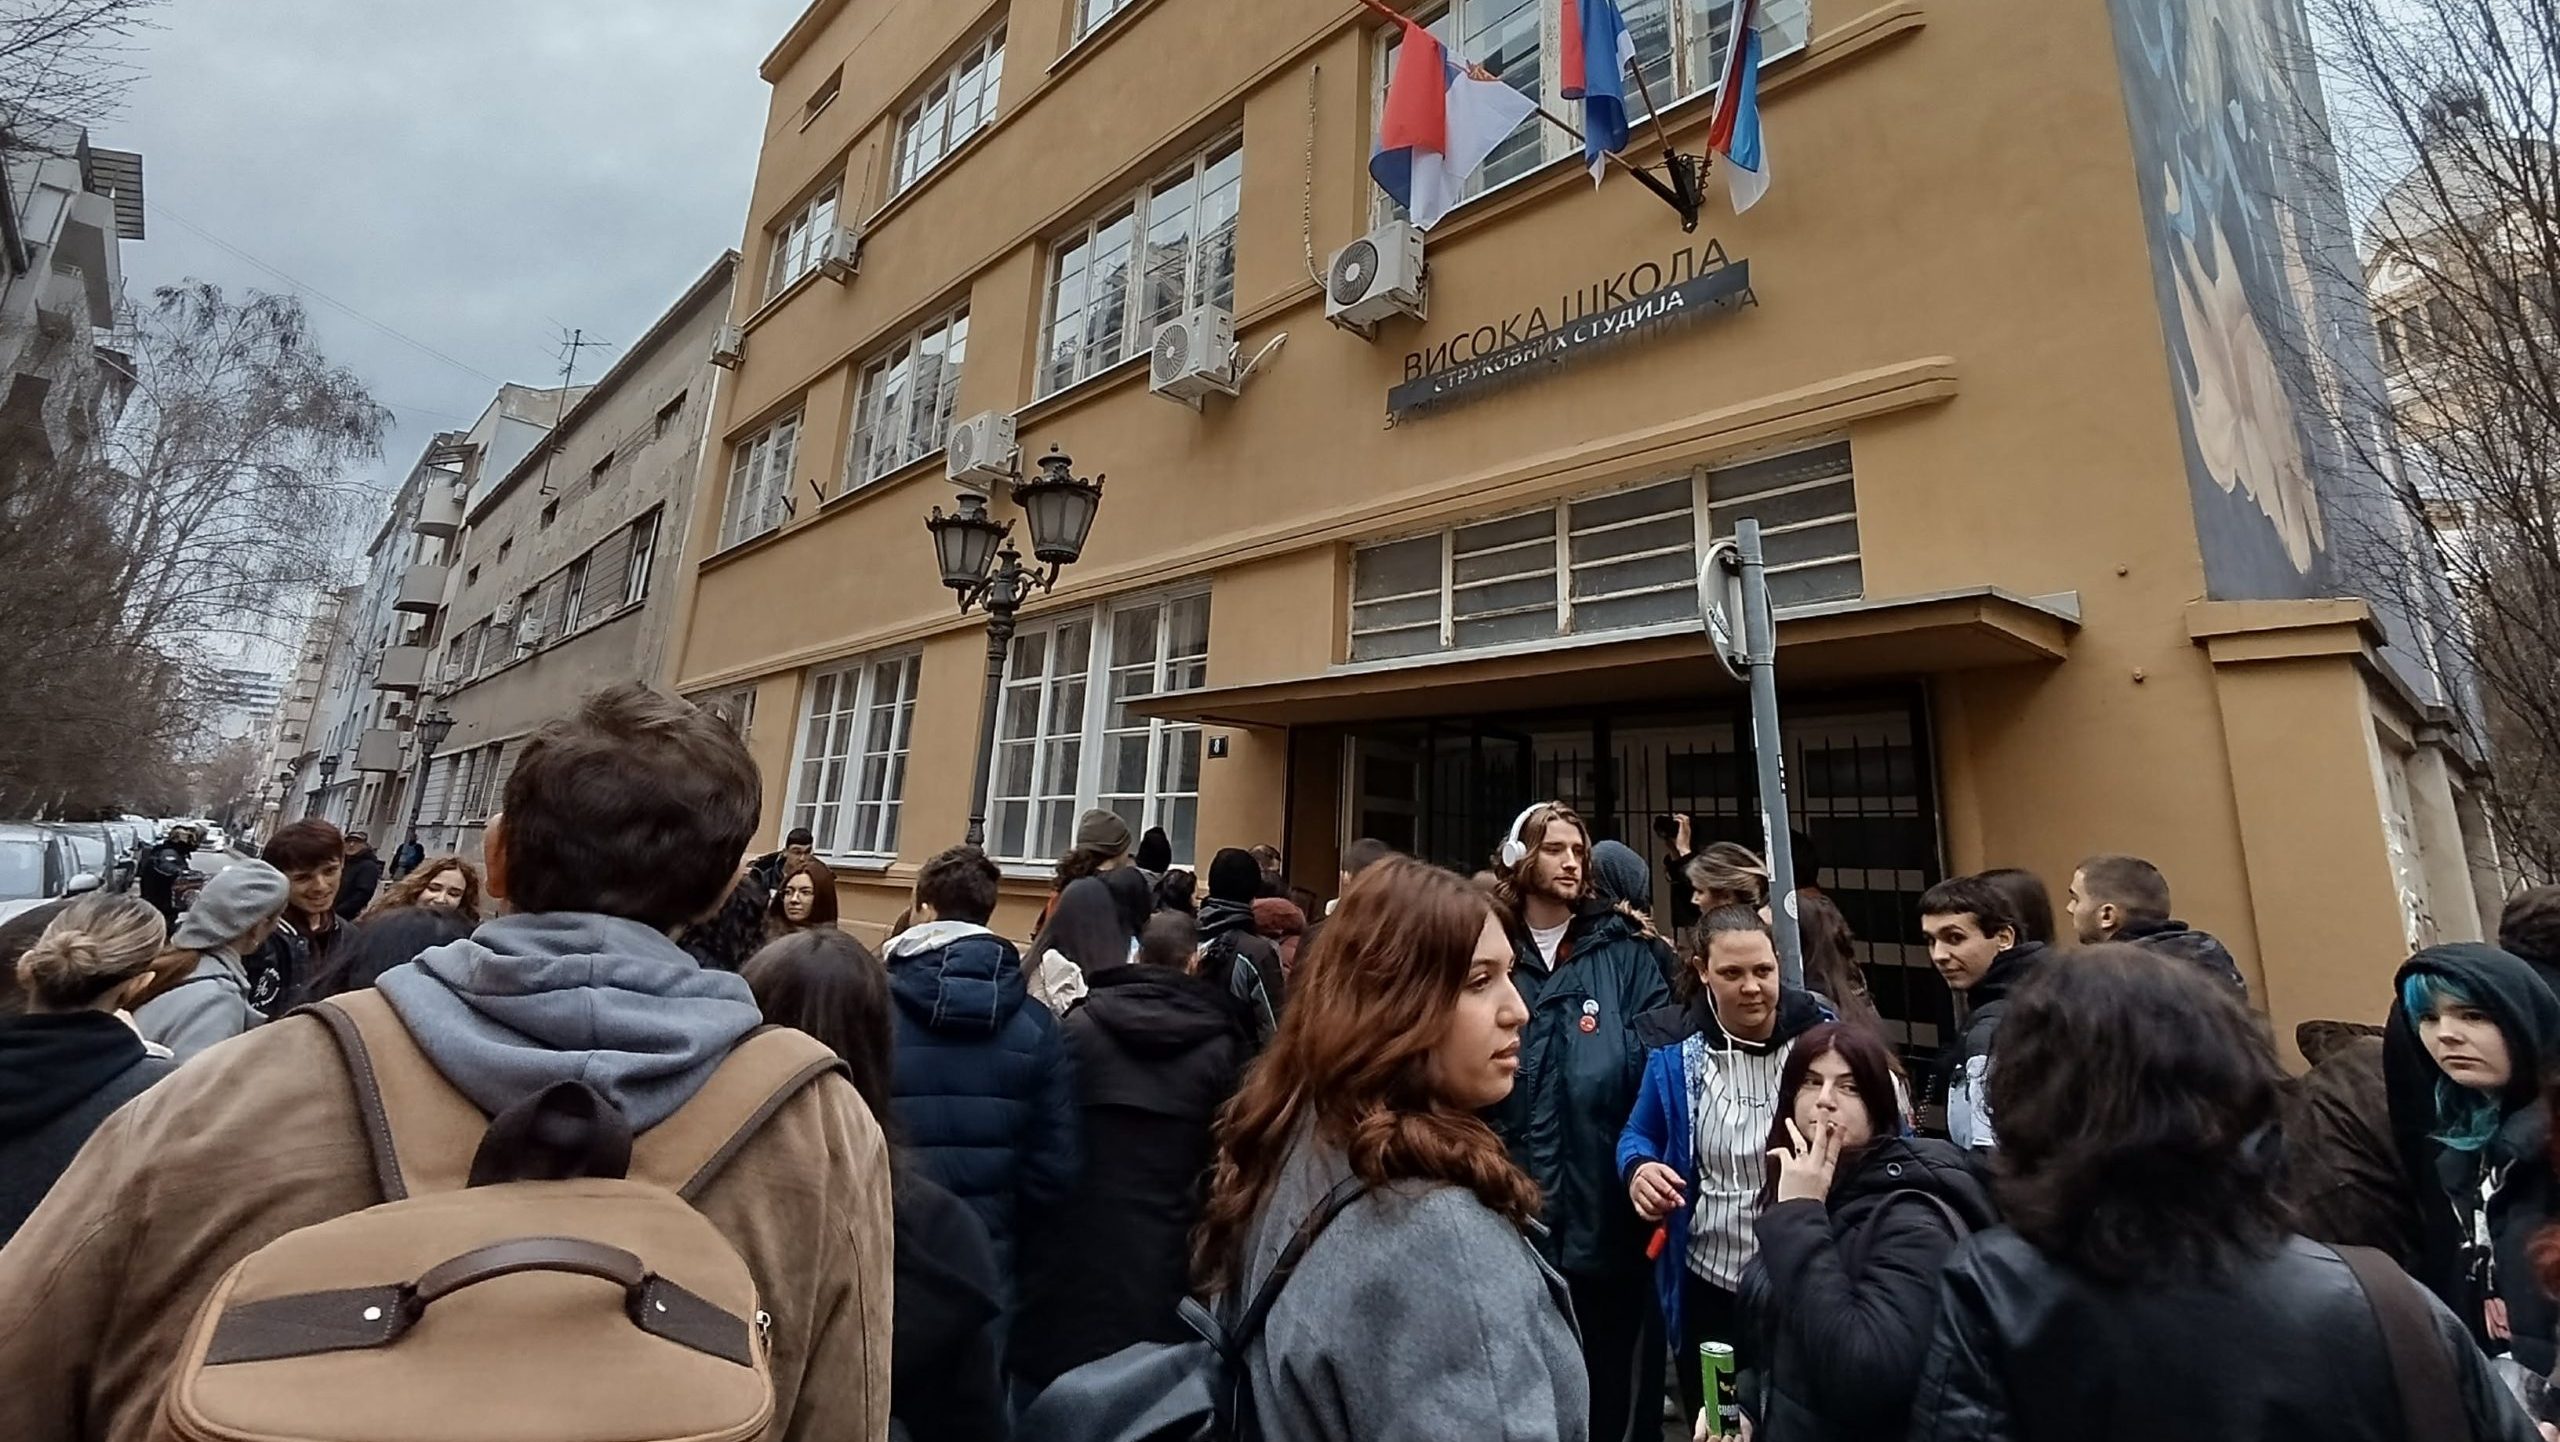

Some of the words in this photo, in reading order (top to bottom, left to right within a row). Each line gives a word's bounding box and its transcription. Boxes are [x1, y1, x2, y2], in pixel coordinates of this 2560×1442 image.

[1404, 306, 1550, 383] ВИСОКА
[1561, 237, 1730, 327] ШКОЛА
[1433, 334, 1568, 393] СТРУКОВНИХ
[1573, 290, 1684, 343] СТУДИЈА
[1213, 738, 1220, 754] 8
